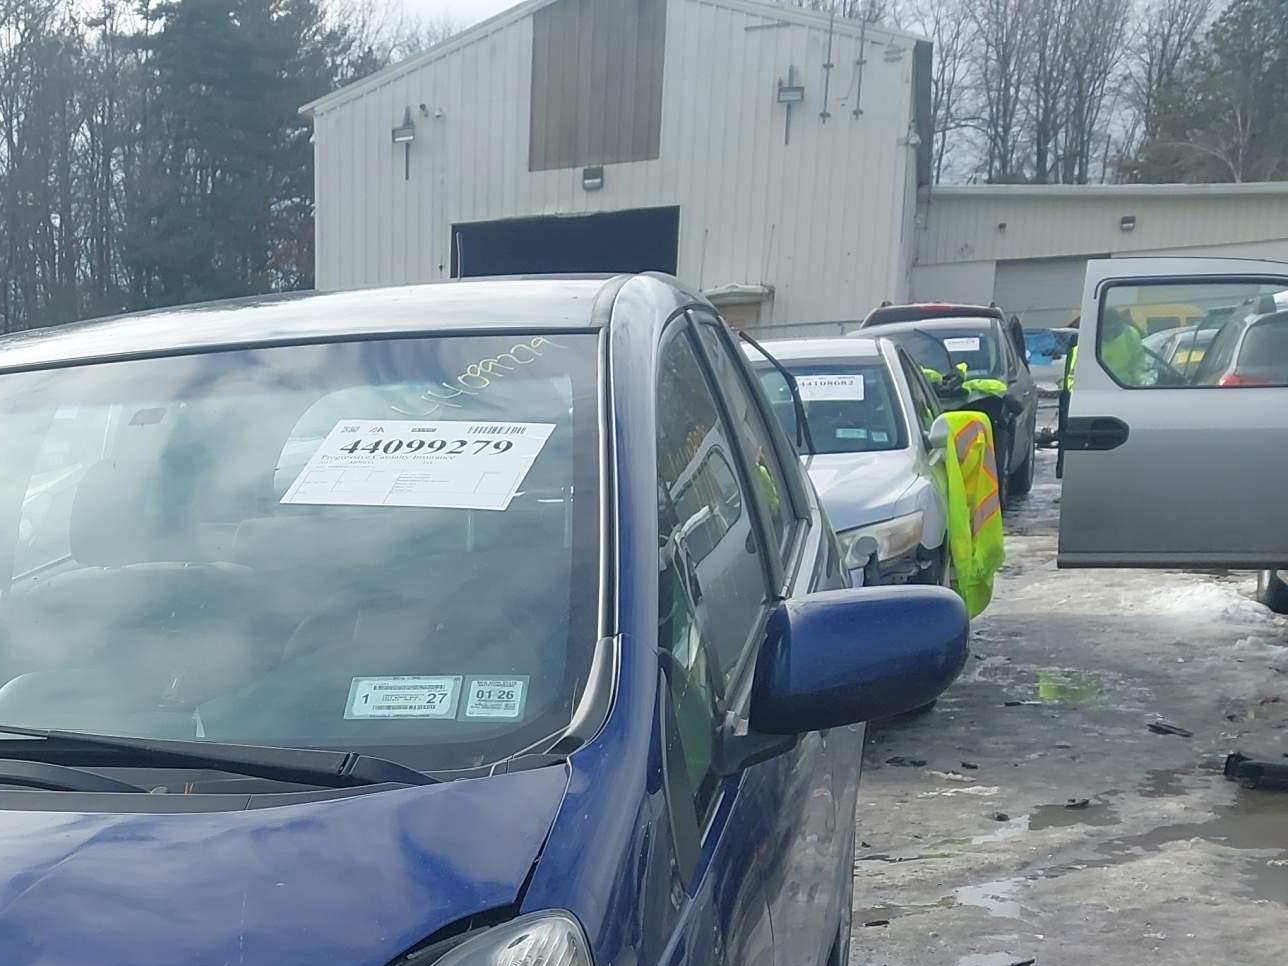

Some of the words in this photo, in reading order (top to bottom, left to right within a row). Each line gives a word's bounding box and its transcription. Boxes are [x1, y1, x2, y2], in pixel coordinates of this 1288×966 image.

[339, 438, 514, 455] 44099279
[361, 693, 369, 704] 1
[425, 692, 448, 704] 27
[497, 689, 514, 699] 26
